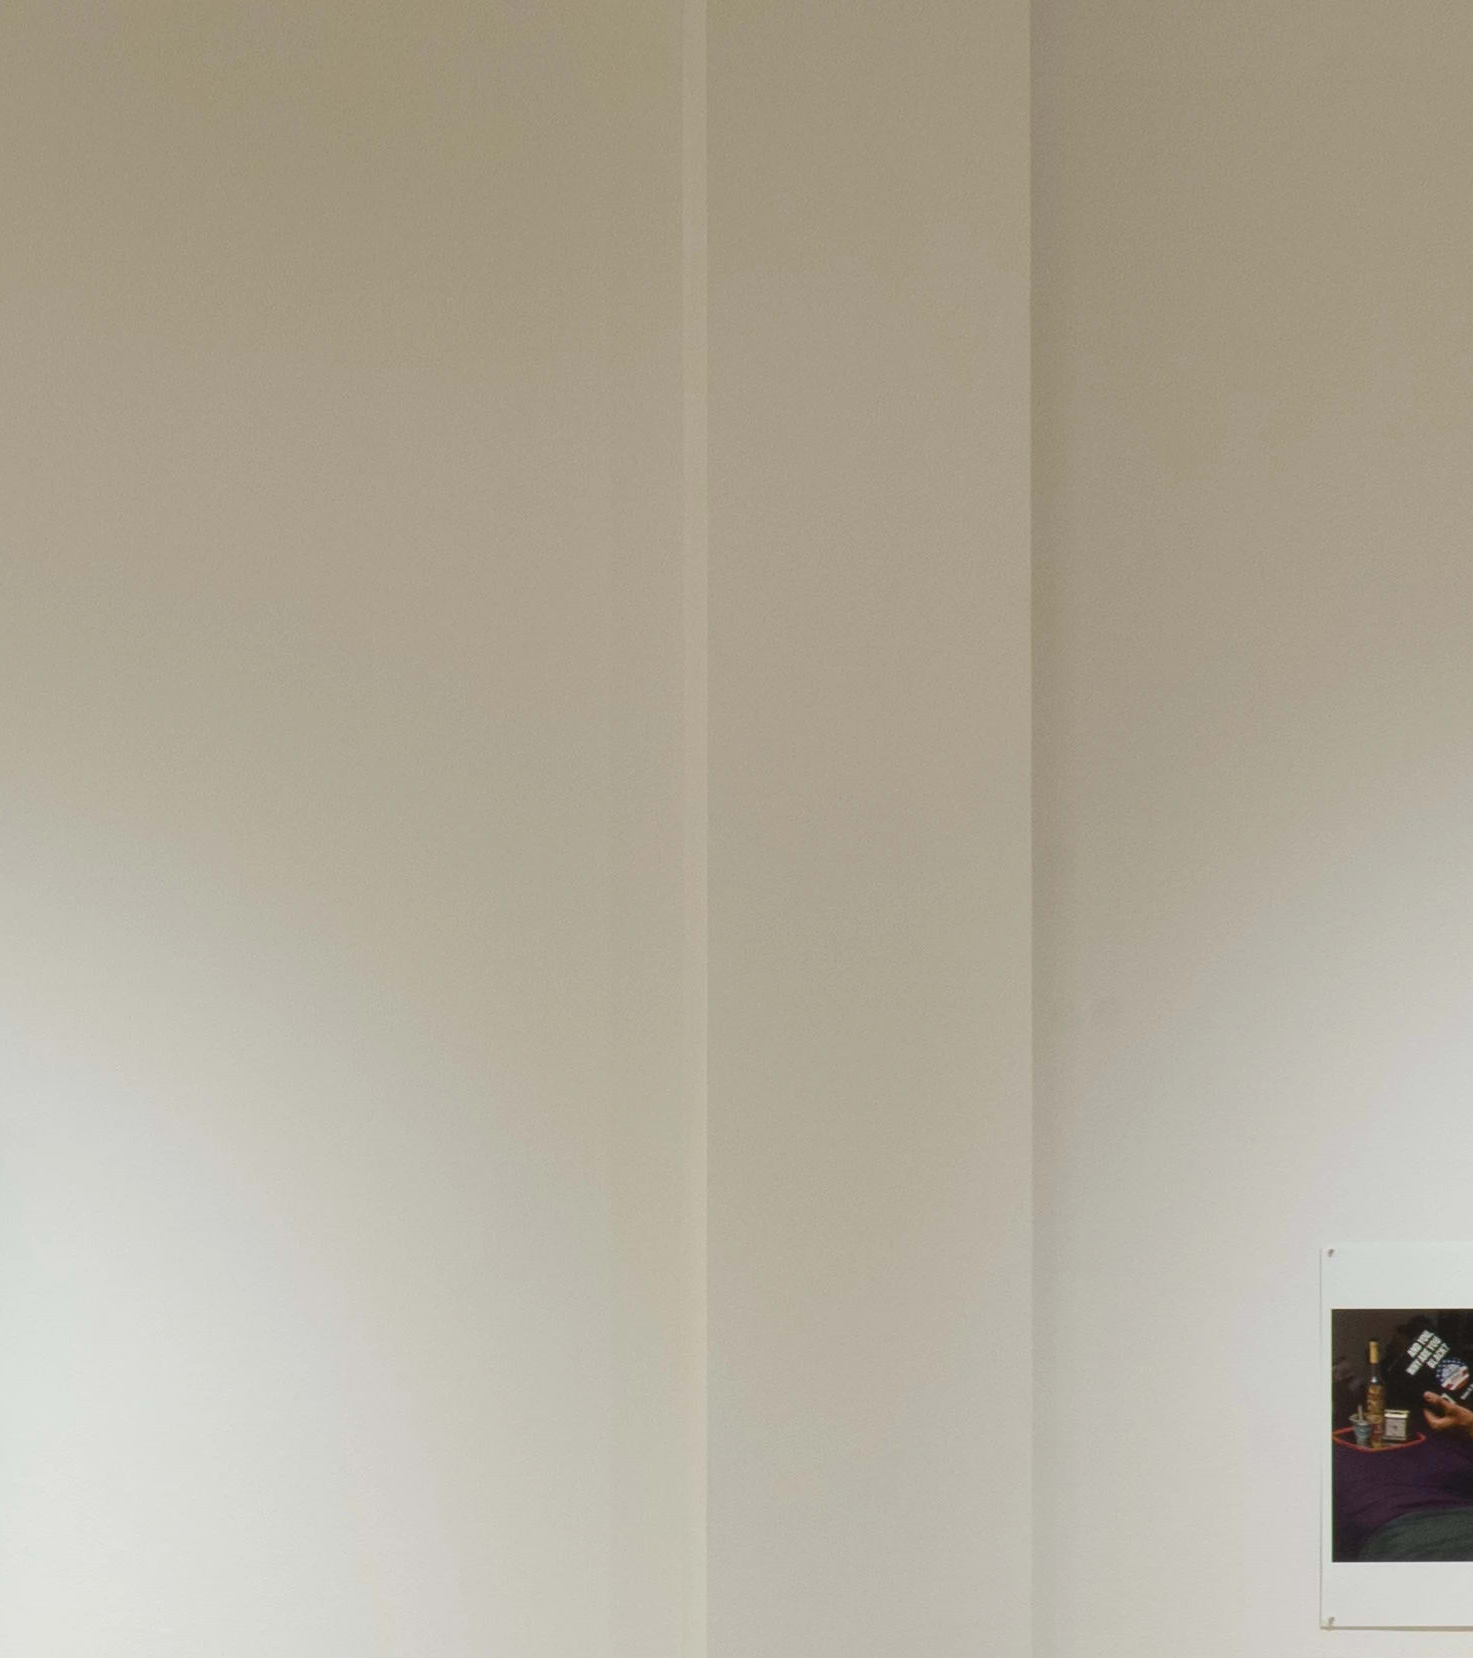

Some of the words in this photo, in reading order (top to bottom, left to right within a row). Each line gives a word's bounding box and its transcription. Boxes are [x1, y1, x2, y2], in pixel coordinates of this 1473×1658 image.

[1405, 1358, 1422, 1375] WHY
[1417, 1347, 1433, 1363] ARE
[1426, 1335, 1442, 1351] YOU
[1406, 1341, 1423, 1358] AND
